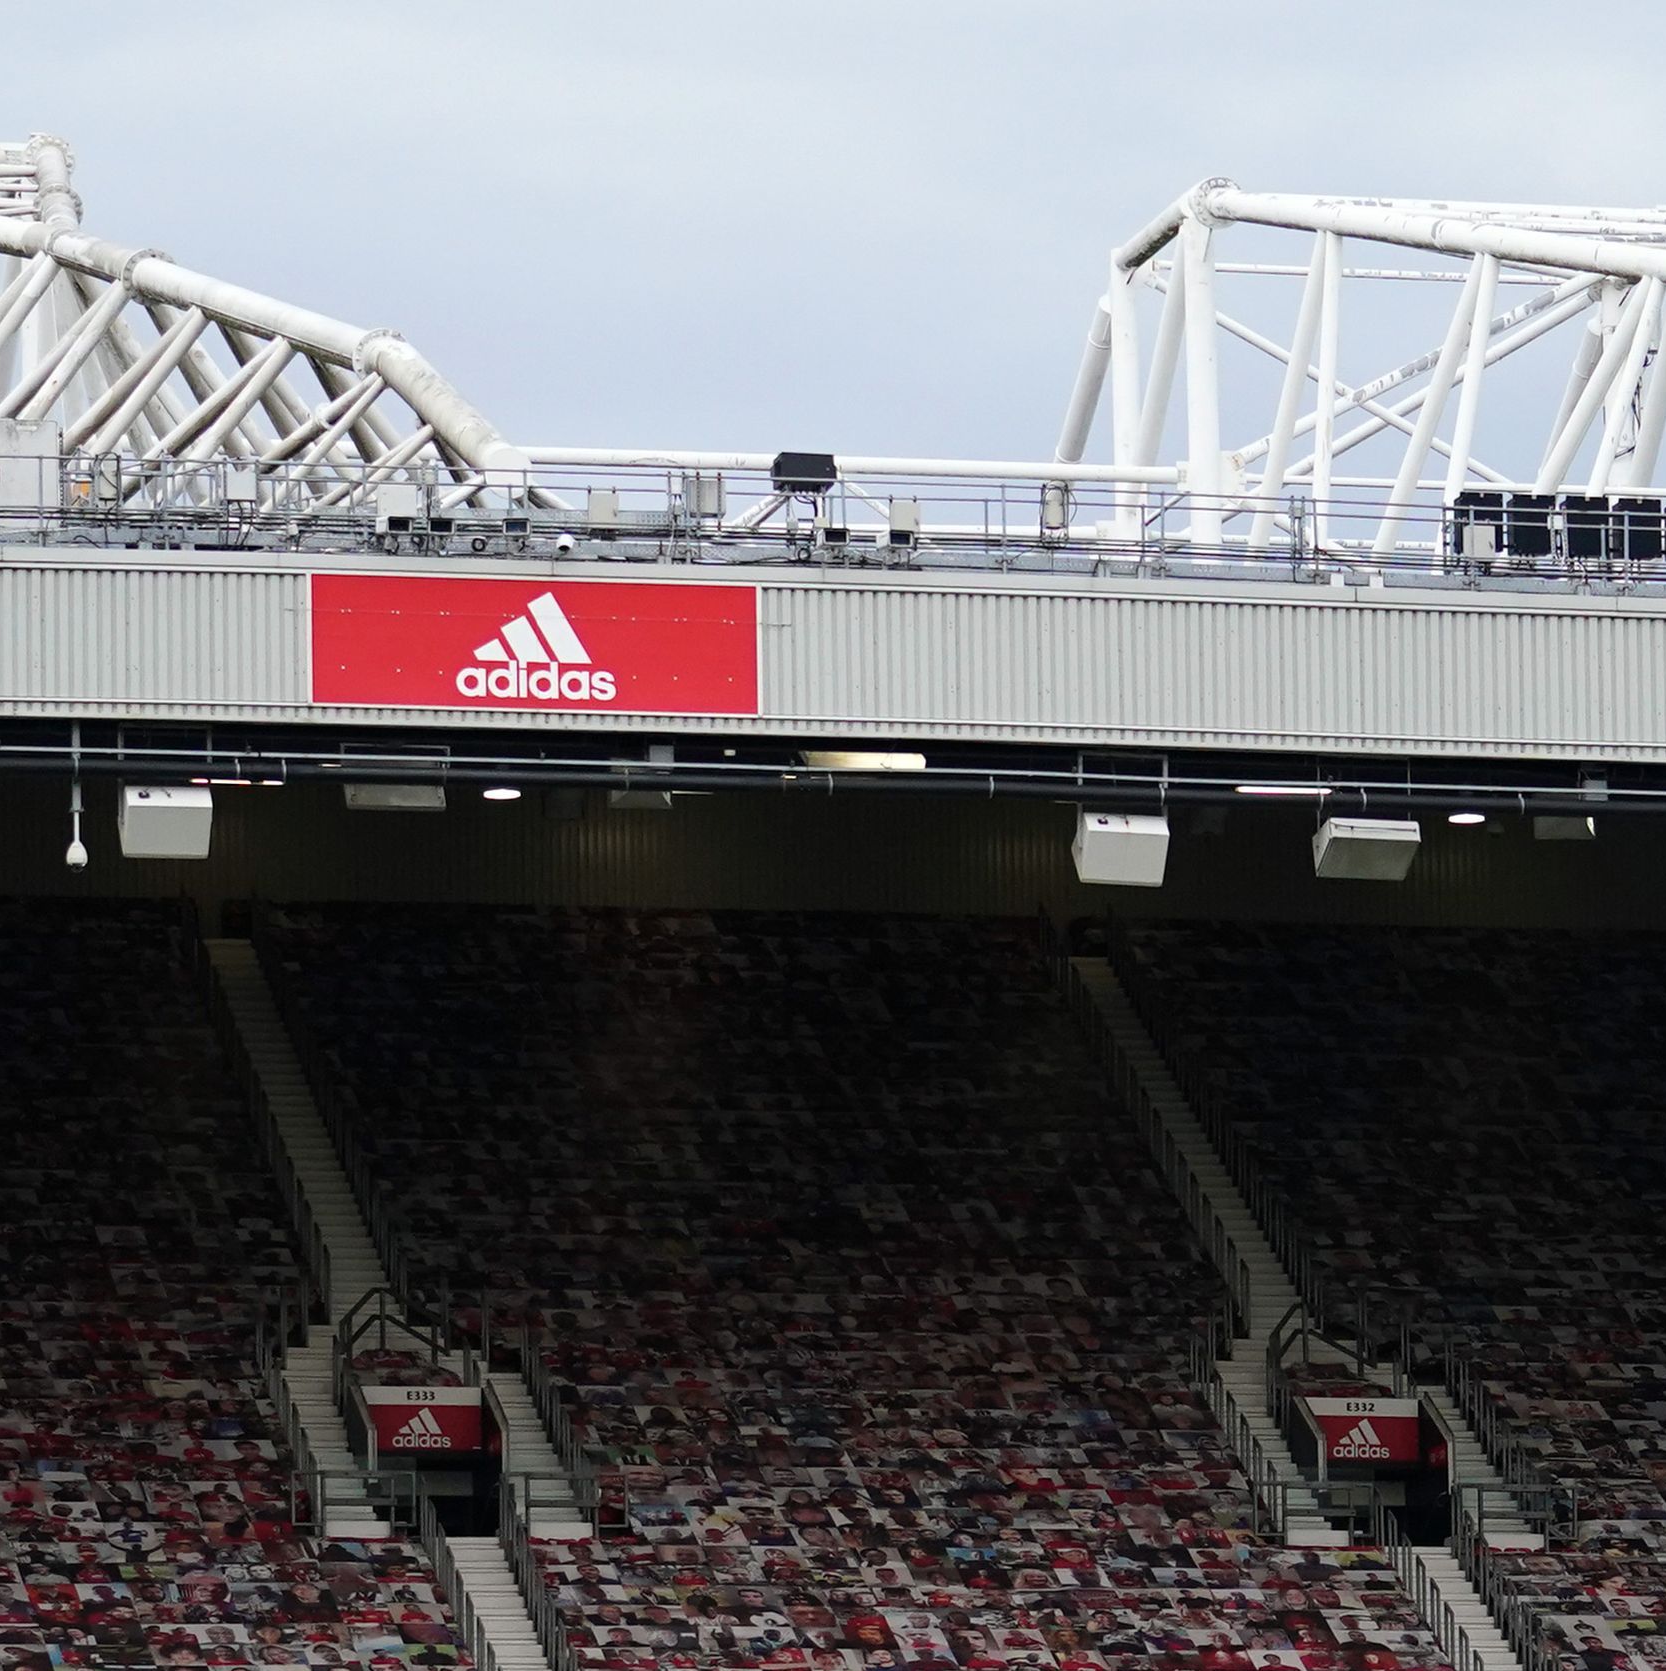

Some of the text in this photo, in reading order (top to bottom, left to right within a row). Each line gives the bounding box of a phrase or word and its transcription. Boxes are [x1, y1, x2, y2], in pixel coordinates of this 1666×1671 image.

[456, 659, 616, 701] adidas
[407, 1391, 435, 1400] E333
[1347, 1402, 1375, 1412] E332
[392, 1433, 451, 1448] adidas
[1333, 1444, 1390, 1458] adidas
